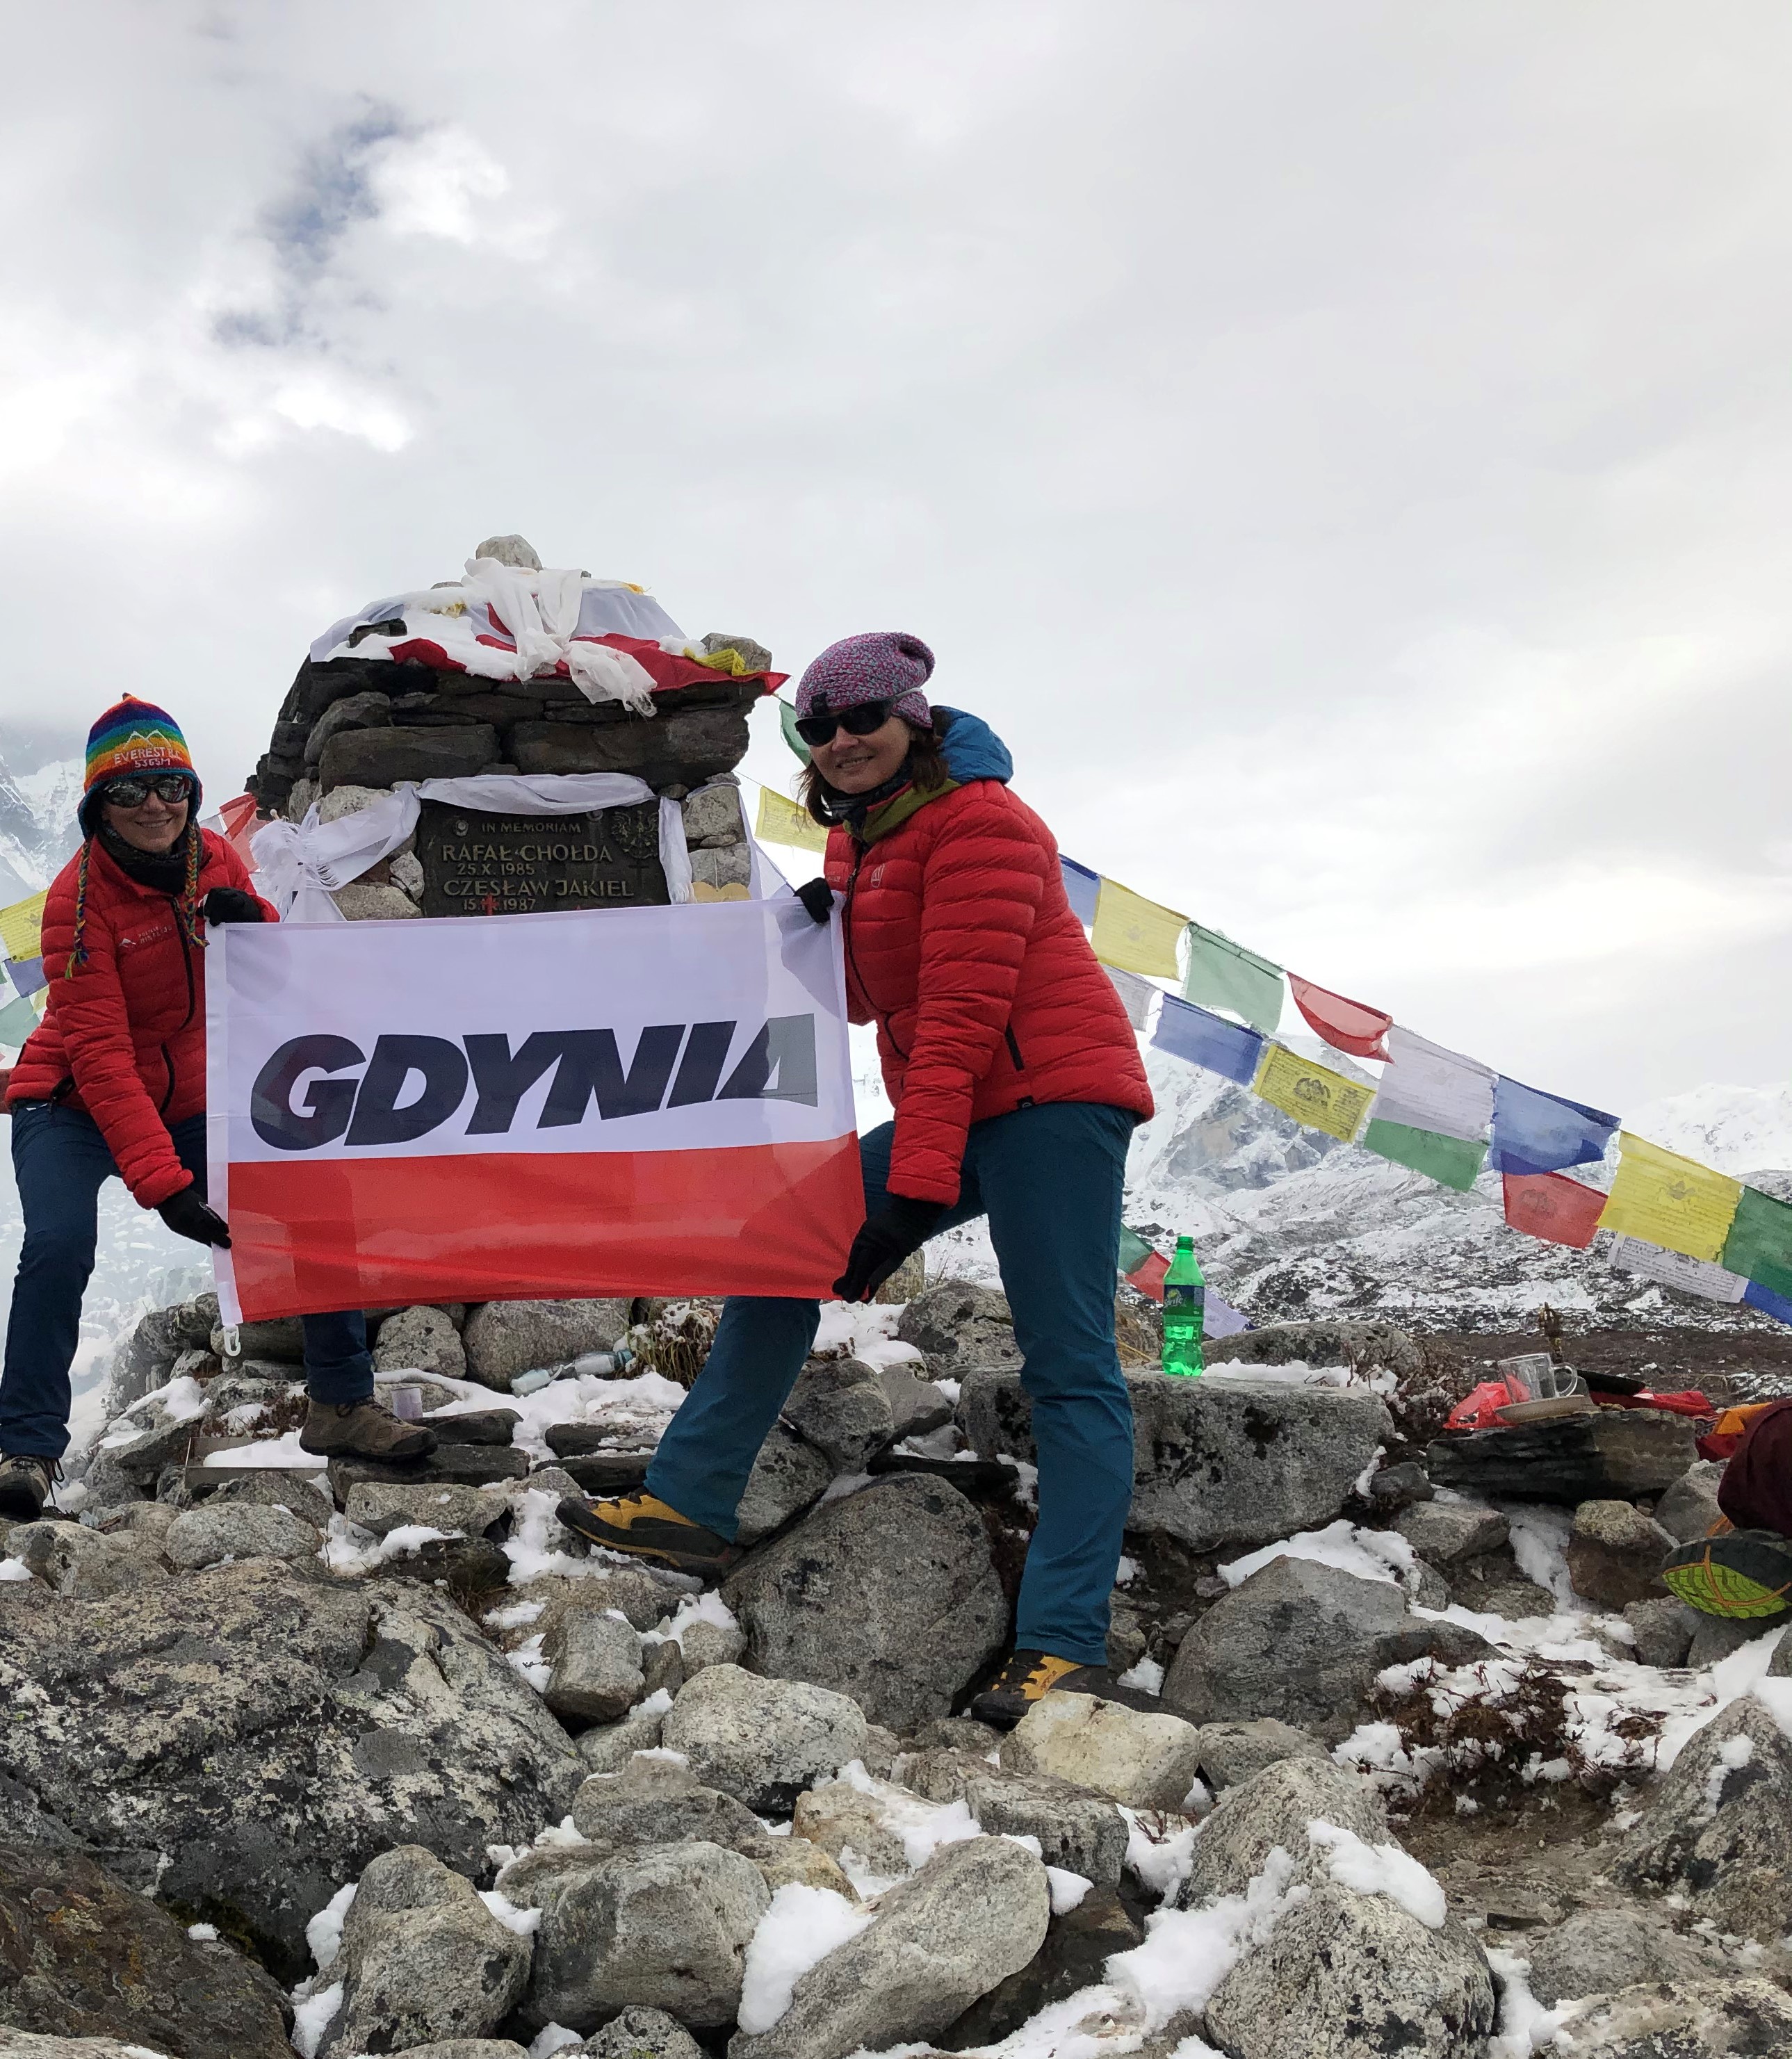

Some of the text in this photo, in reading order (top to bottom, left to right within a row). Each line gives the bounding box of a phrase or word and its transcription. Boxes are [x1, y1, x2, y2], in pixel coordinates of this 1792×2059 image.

[113, 747, 166, 765] EVEREST
[481, 822, 582, 834] IN MEMORIAM
[442, 844, 613, 863] RAFAŁ CHOŁDA
[443, 879, 635, 897] CZESŁAW JAKIEL
[250, 1012, 820, 1151] GDYNIA
